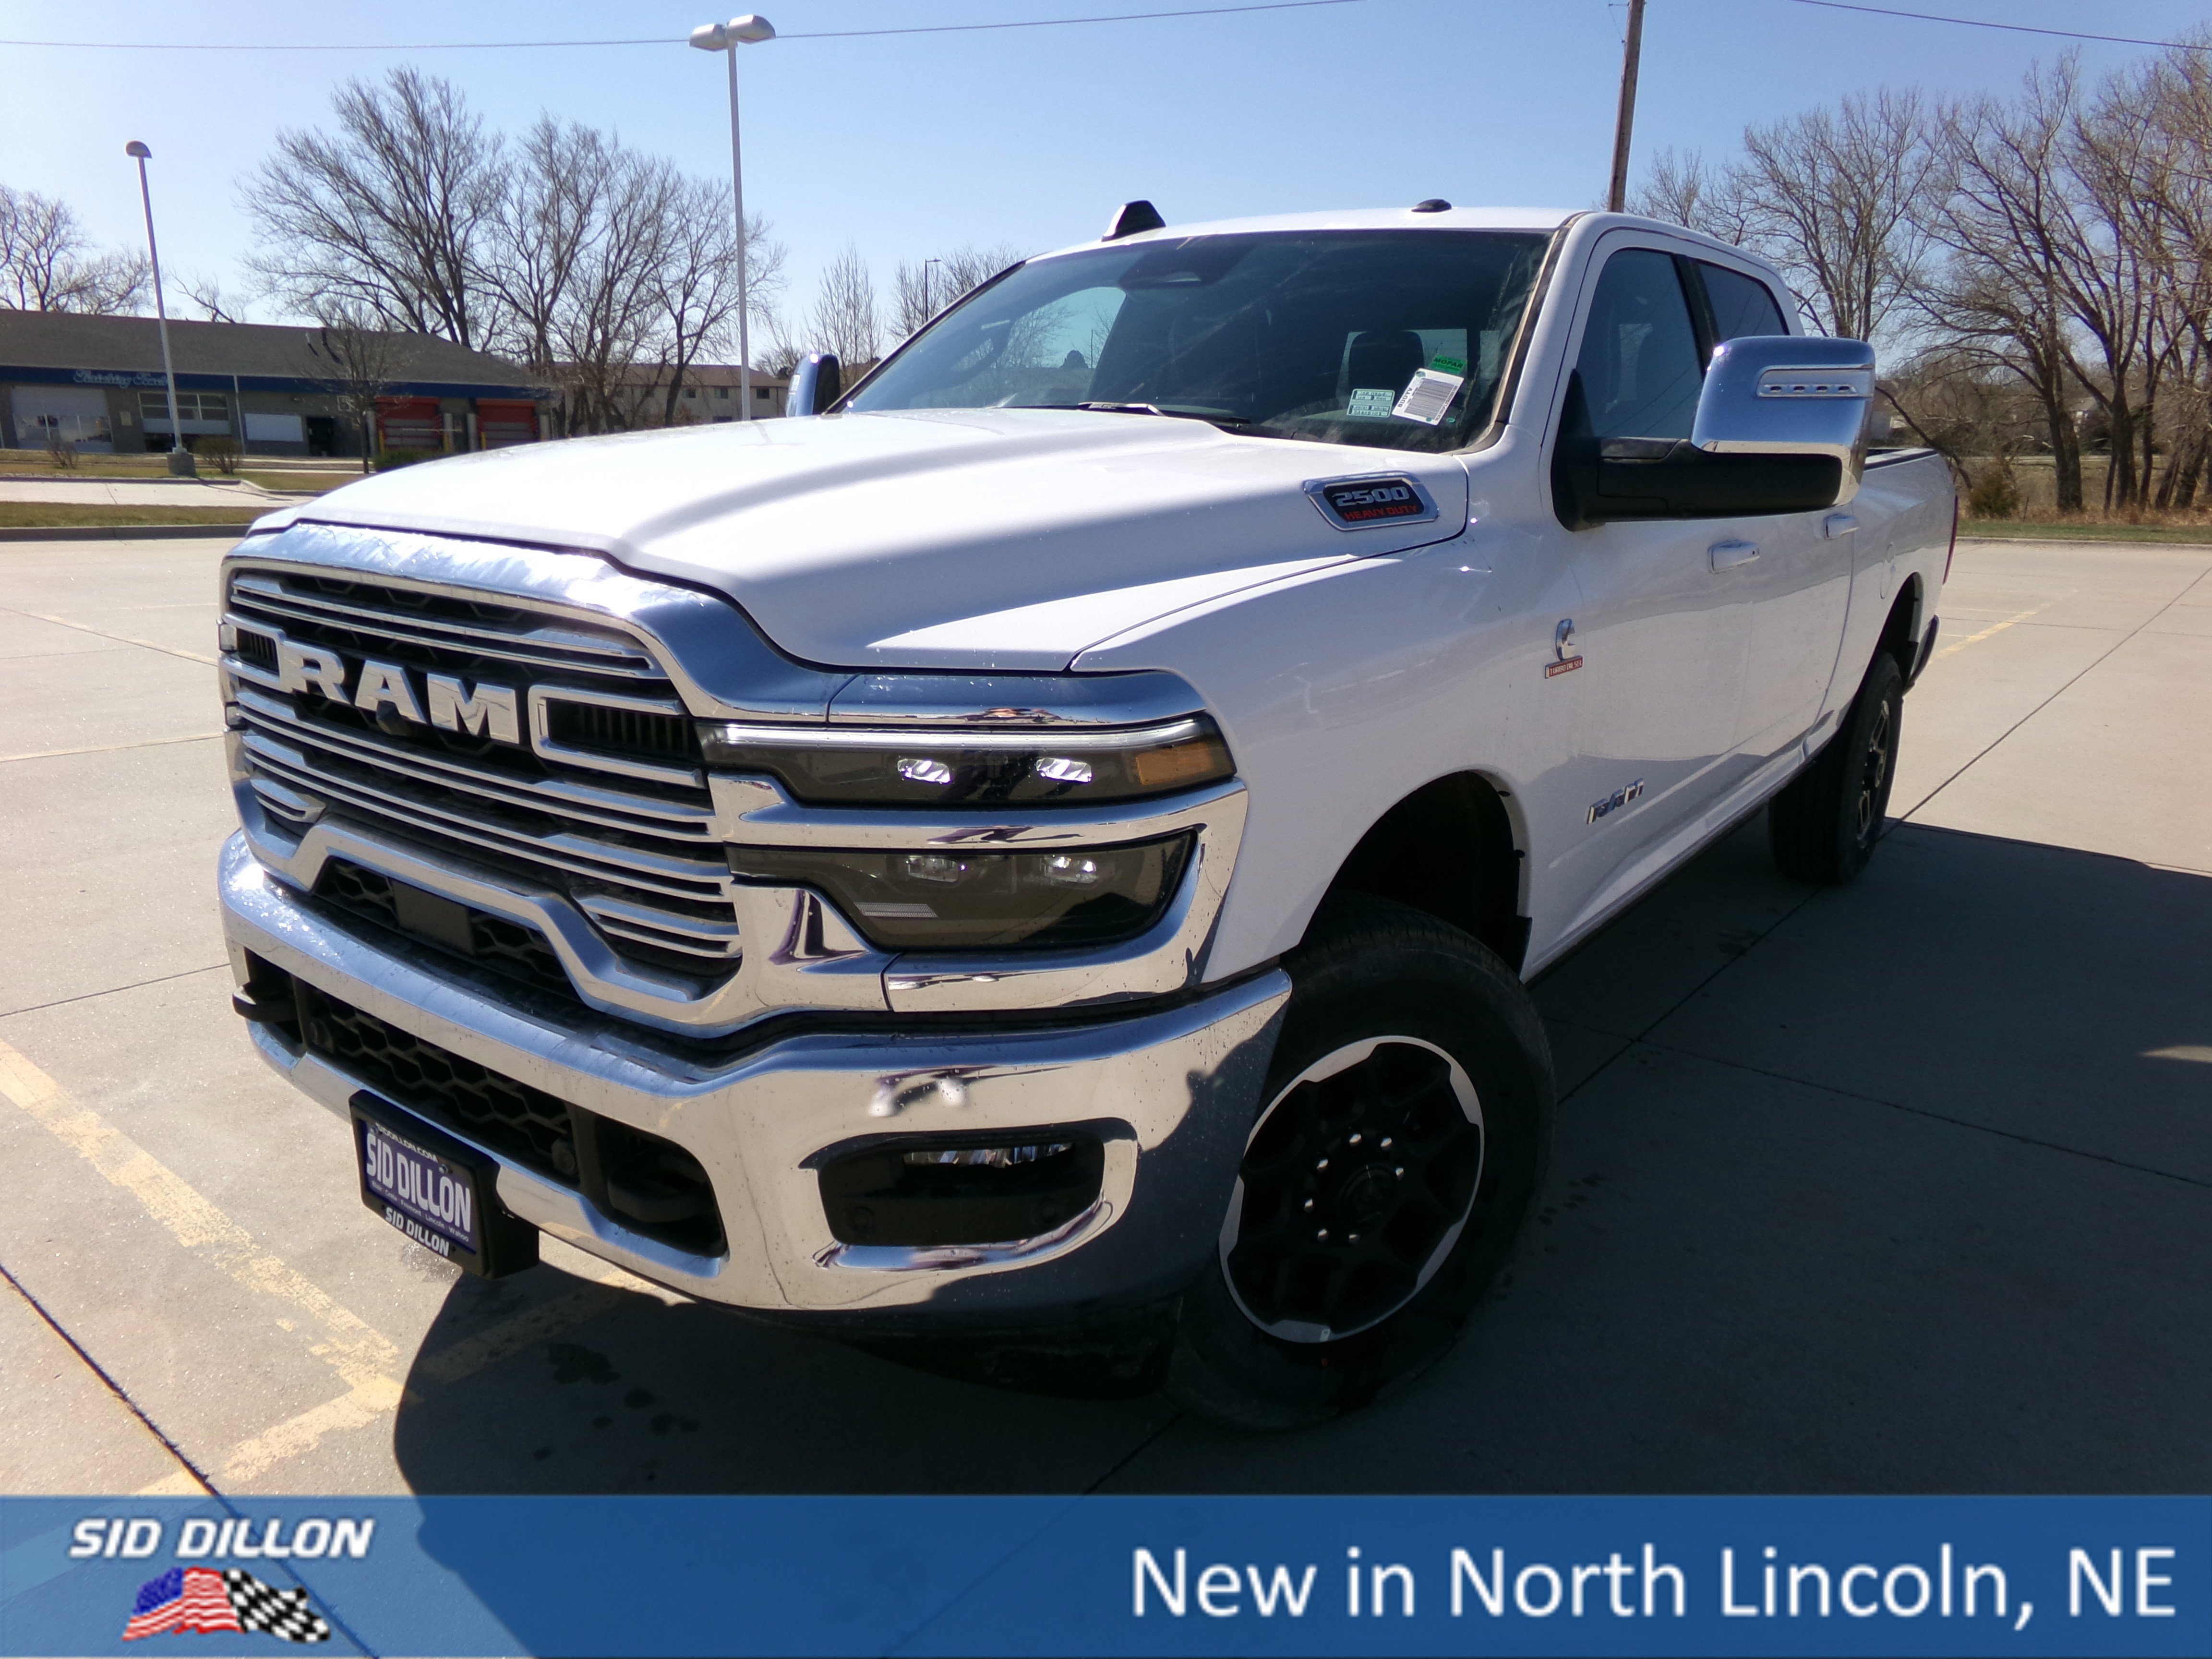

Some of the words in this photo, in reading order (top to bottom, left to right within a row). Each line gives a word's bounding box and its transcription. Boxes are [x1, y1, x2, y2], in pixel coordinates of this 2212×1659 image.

[1433, 357, 1463, 369] MOPAR
[1332, 486, 1409, 507] 2500
[1345, 508, 1384, 520] HEAVY
[1386, 505, 1418, 515] DUTY
[1550, 665, 1566, 675] TURBO
[1566, 659, 1582, 671] DIESEL
[280, 639, 519, 744] RAM
[367, 1133, 394, 1189] SID
[397, 1152, 471, 1233] DILLON
[385, 1207, 404, 1230] SID
[406, 1222, 449, 1257] DILLON
[425, 1214, 445, 1229] Lincoln
[448, 1226, 469, 1242] Wahoo
